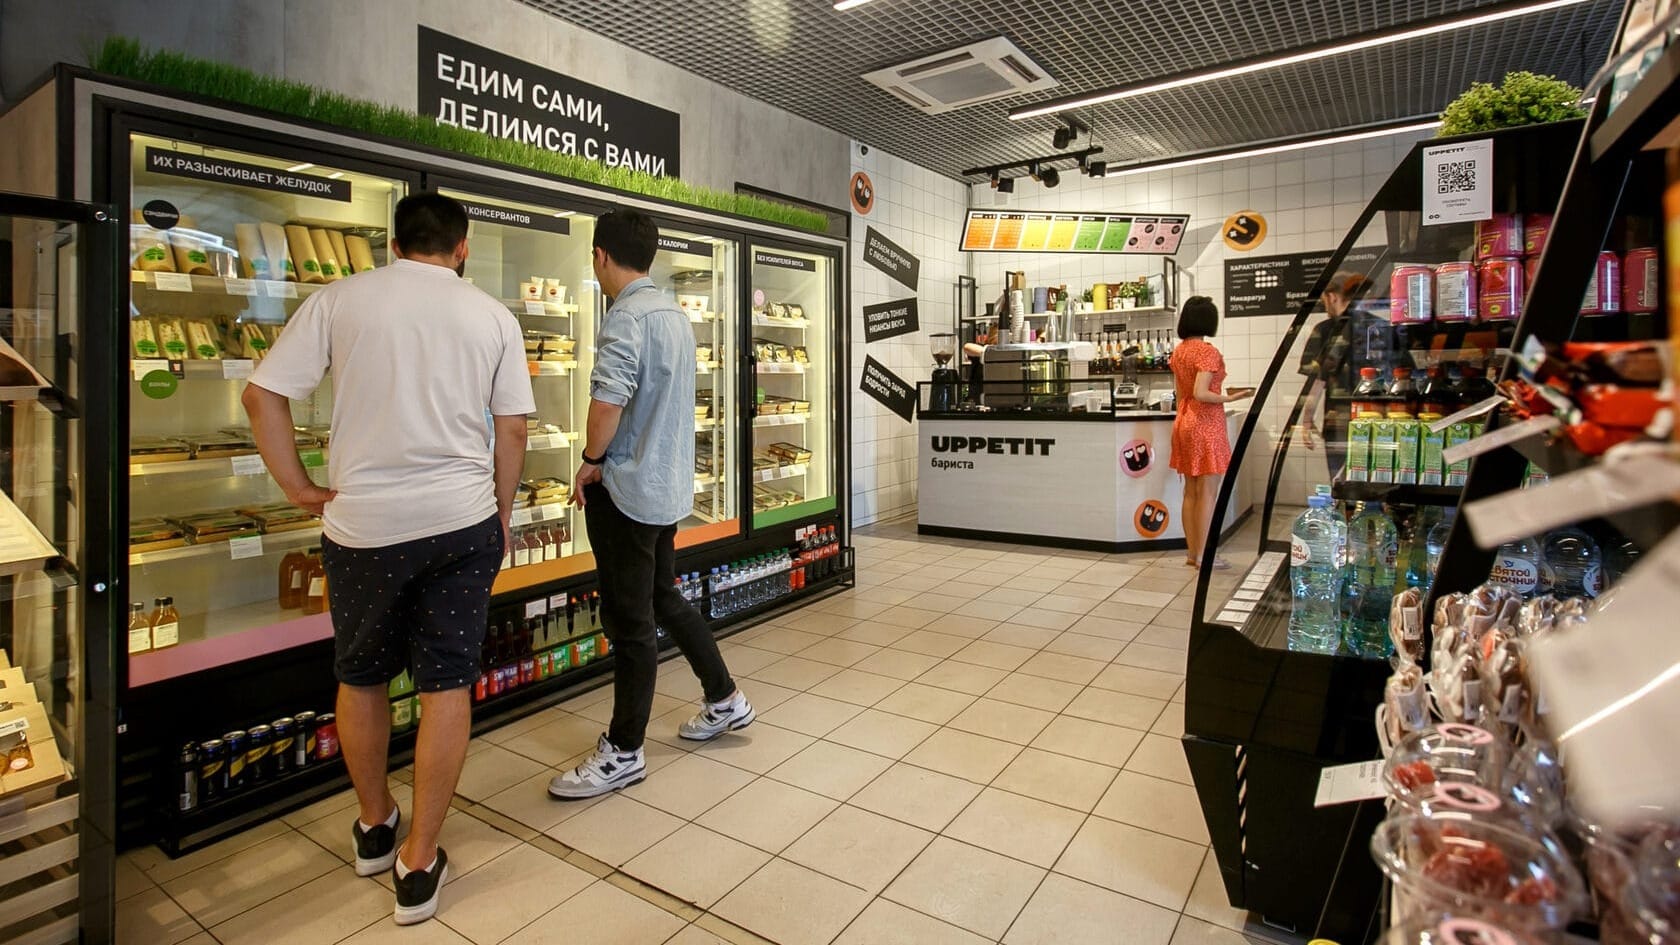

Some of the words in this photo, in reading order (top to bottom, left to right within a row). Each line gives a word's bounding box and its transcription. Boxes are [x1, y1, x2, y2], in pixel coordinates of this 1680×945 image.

[437, 52, 524, 104] ЕДИМ
[532, 83, 610, 132] САМИ,
[436, 97, 576, 156] ДЕЛИМСЯ
[583, 138, 599, 161] С
[605, 142, 666, 177] ВАМИ
[1428, 147, 1466, 156] UPPETIT
[153, 154, 173, 169] ИХ
[176, 159, 274, 185] РАЗЫСКИВАЕТ
[275, 175, 331, 194] ЖЕЛУДОК
[468, 206, 530, 224] КОНСЕРВАНТОВ
[663, 239, 689, 250] КАЛОРИИ
[870, 237, 890, 256] ДЕЛАЕМ
[1230, 260, 1290, 271] ХАРАКТЕРИСТИКИ
[1302, 256, 1330, 265] ВКУСОВ
[1345, 253, 1377, 261] РОФИЛЬ
[1230, 294, 1266, 303] Никарагуа
[1286, 291, 1309, 299] Брази
[889, 307, 908, 318] ТОНКИЕ
[869, 321, 890, 333] НЮАНСЫ
[890, 318, 906, 329] ВКУСА
[864, 375, 890, 398] БОДРОСТИ
[867, 364, 891, 387] ПОЛУЧИТЬ
[890, 382, 906, 399] ЗАРЯД
[931, 435, 1056, 456] UPPETIT
[931, 457, 974, 470] бариста
[1494, 565, 1530, 577] ВЯТОЙ
[1490, 575, 1537, 584] СТОЧНИК
